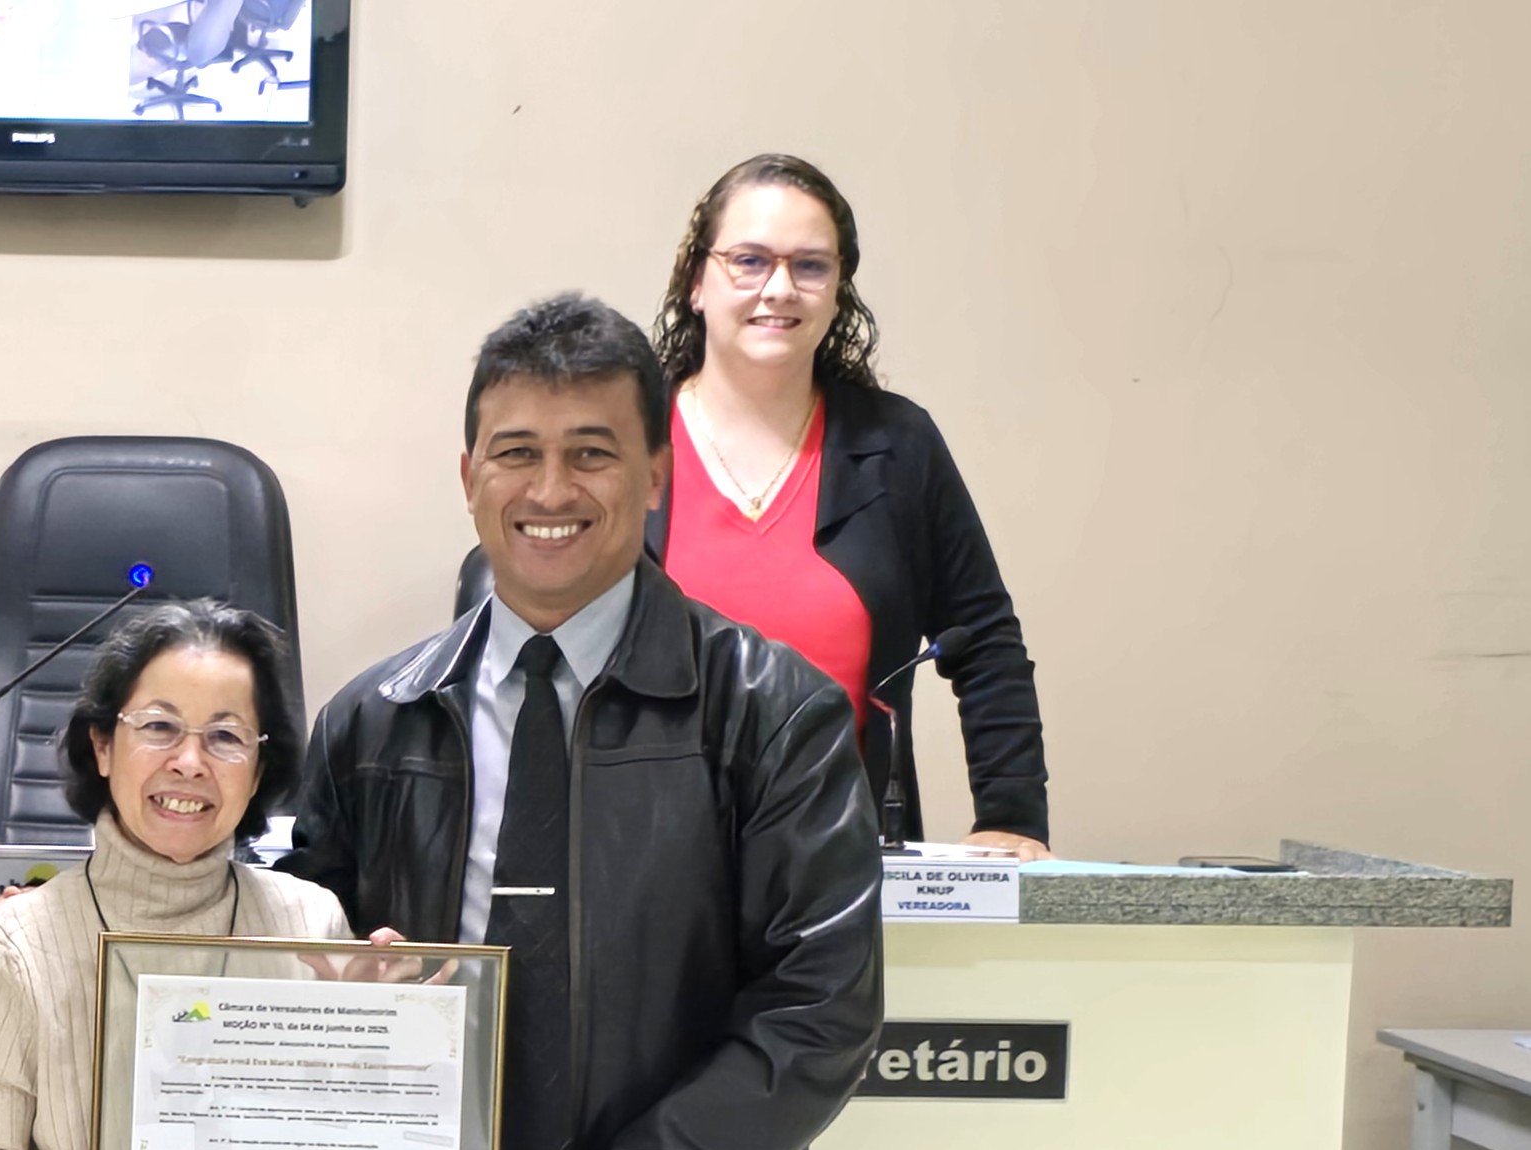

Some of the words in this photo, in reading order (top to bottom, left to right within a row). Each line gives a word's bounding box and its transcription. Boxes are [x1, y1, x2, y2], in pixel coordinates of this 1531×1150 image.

[11, 132, 56, 144] PHILIPS
[926, 871, 944, 881] DE
[948, 871, 1010, 882] OLIVEIRA
[916, 885, 955, 896] KNUP
[897, 900, 972, 911] VEREADORA
[256, 1004, 267, 1012] de
[323, 1006, 335, 1015] de
[287, 1023, 298, 1031] de
[313, 1024, 324, 1032] de
[354, 1025, 365, 1033] de
[861, 1039, 1048, 1082] etário
